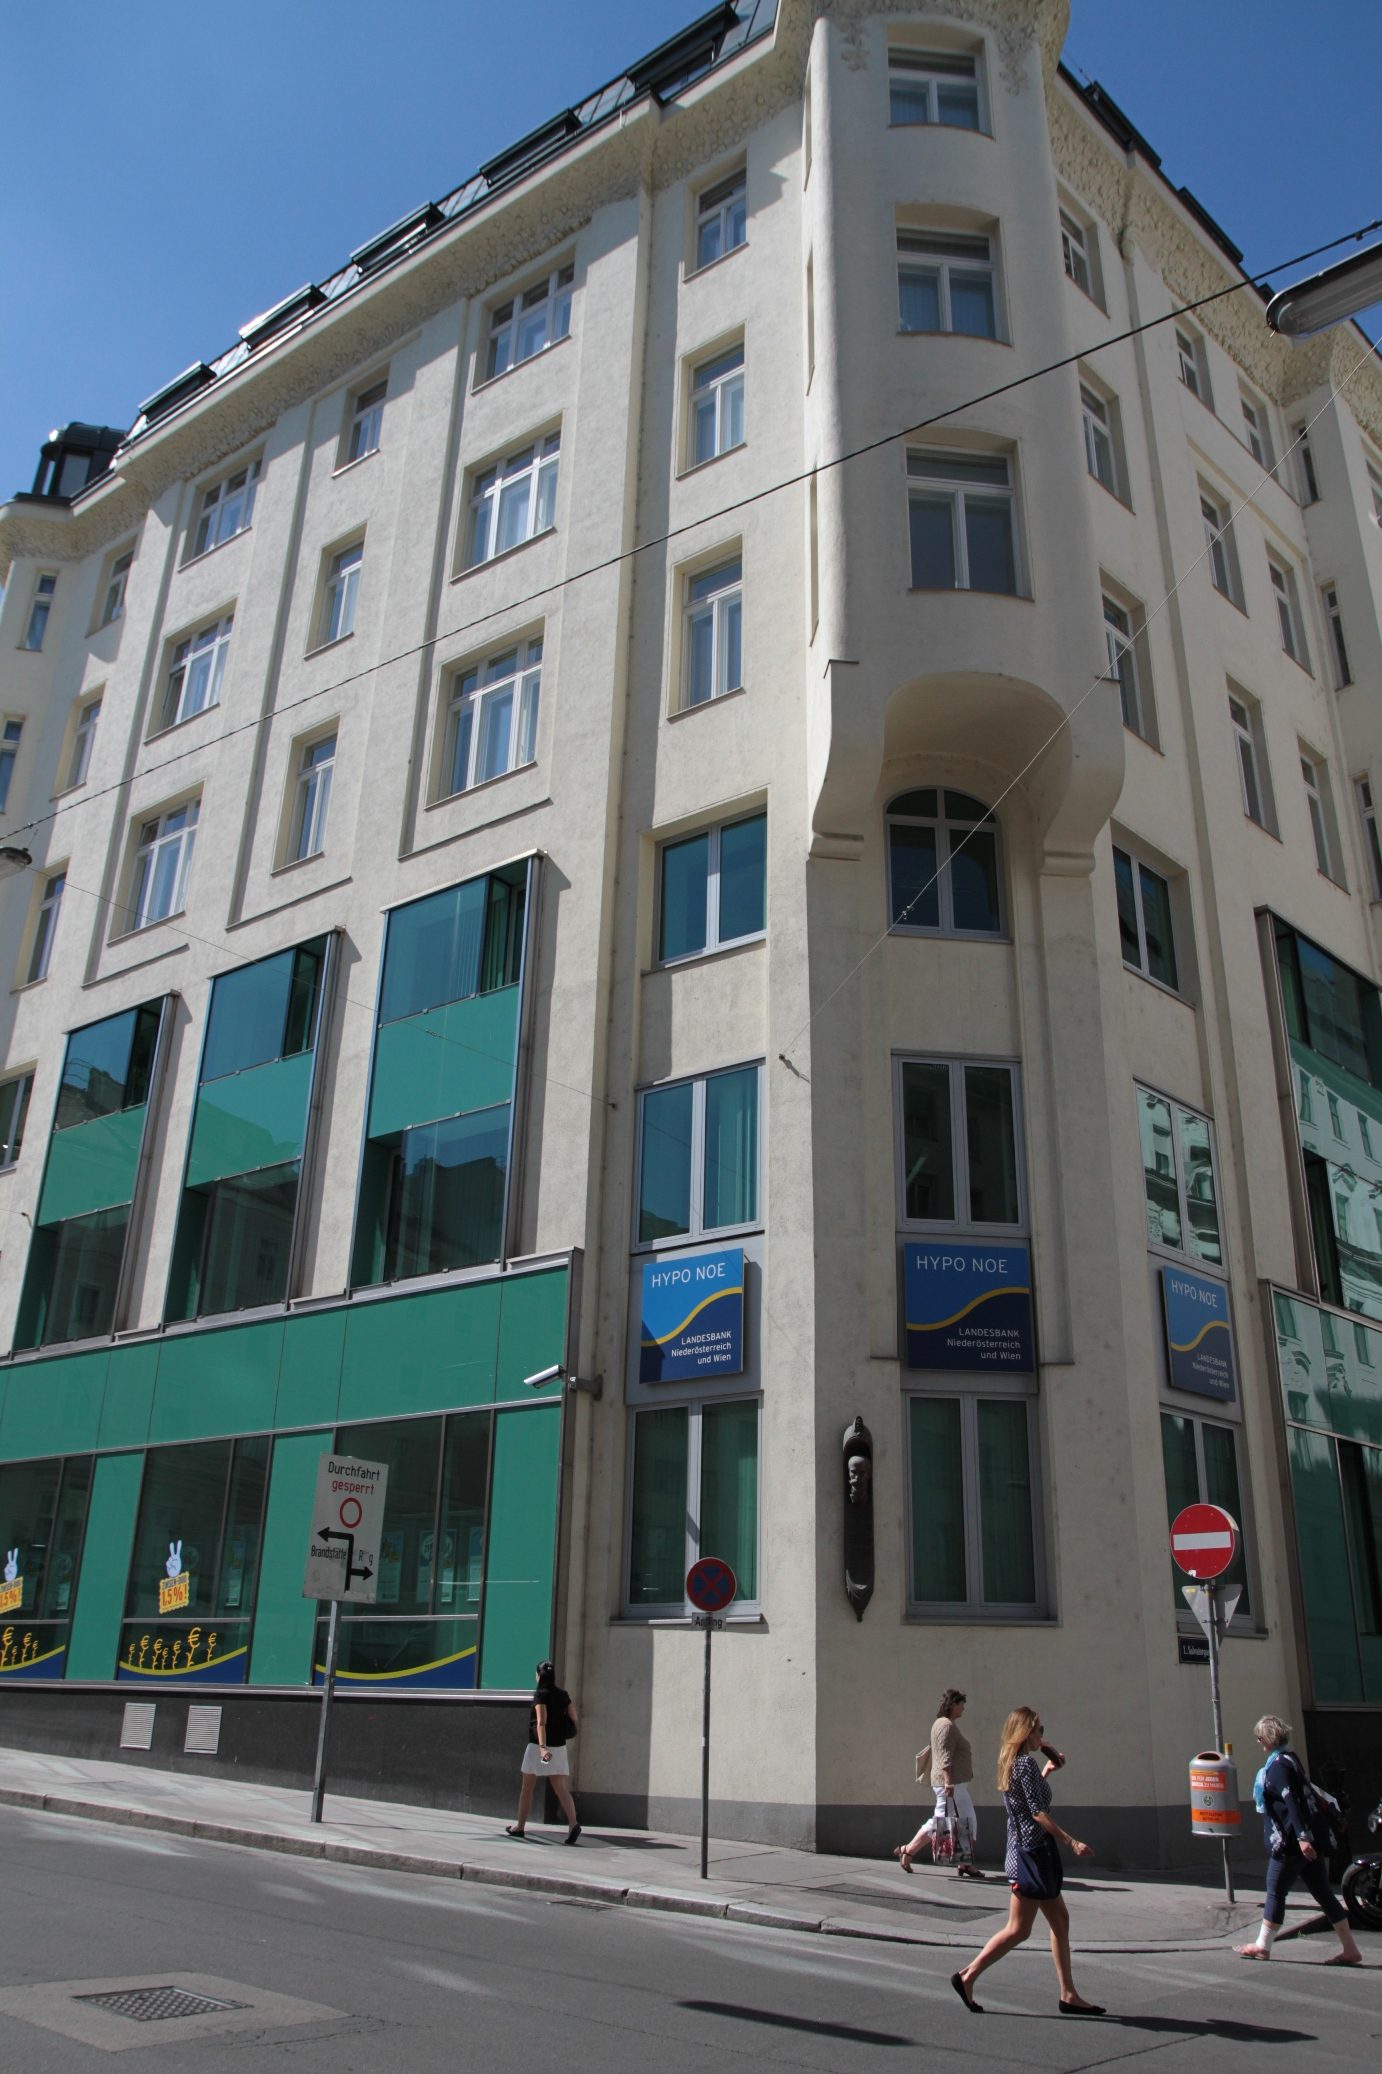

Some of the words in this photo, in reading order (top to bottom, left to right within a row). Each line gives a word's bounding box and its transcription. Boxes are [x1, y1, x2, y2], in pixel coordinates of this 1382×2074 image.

[916, 1255, 966, 1272] HYPO
[972, 1258, 1008, 1273] NOE
[651, 1268, 691, 1288] HYPO
[696, 1262, 726, 1280] NOE
[1171, 1279, 1197, 1300] HYPO
[1198, 1289, 1218, 1308] NOE
[681, 1330, 732, 1345] LANDESBANK
[958, 1327, 1020, 1337] LANDESBANK
[671, 1342, 732, 1357] Niederösterreich
[947, 1338, 1021, 1349] Niederösterreich
[697, 1355, 712, 1365] und
[713, 1353, 732, 1362] Wien
[980, 1351, 997, 1359] und
[999, 1352, 1021, 1360] Wien
[328, 1461, 380, 1481] Durchfahrt
[331, 1480, 374, 1495] gesperrt
